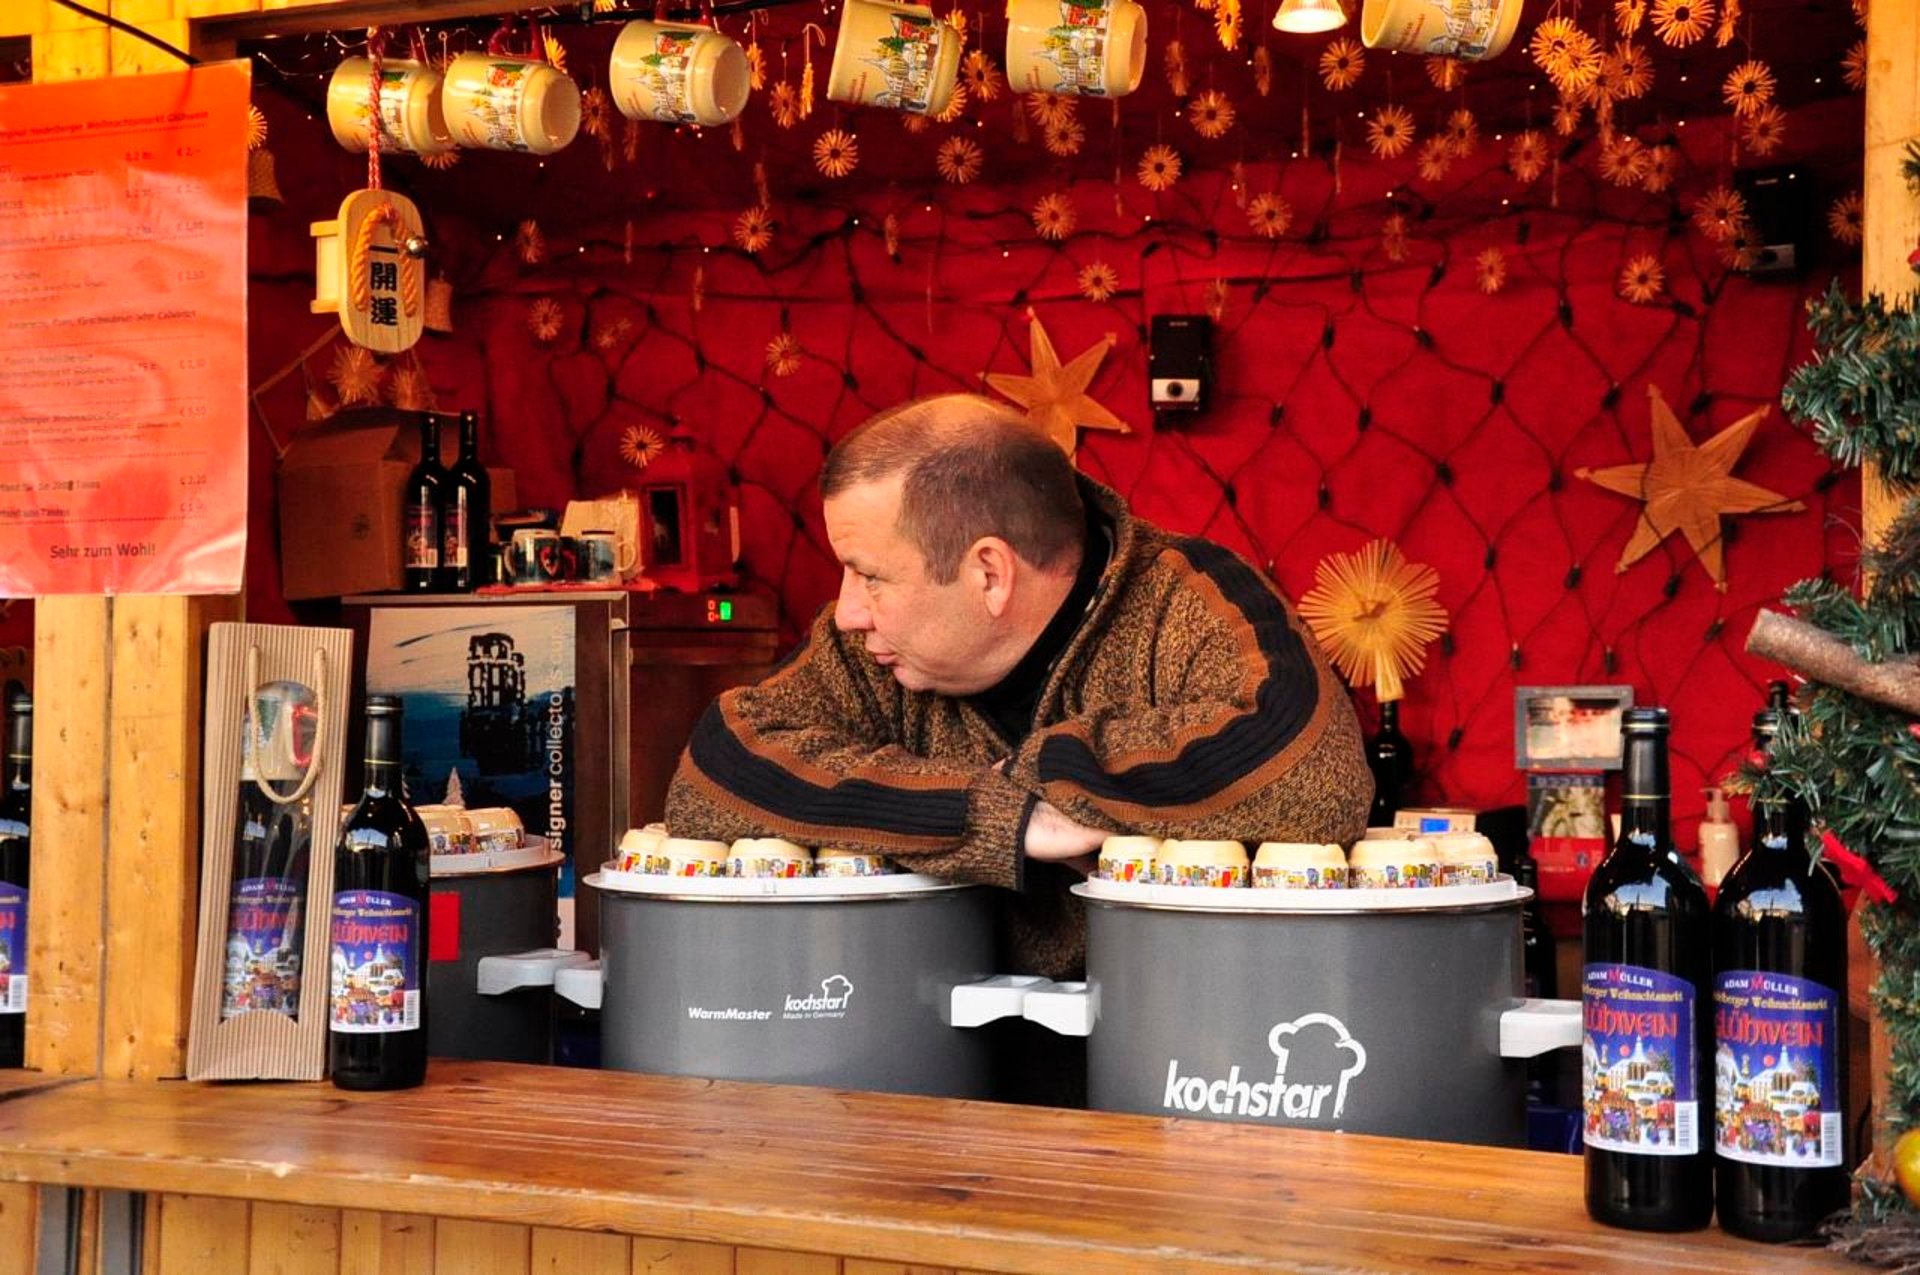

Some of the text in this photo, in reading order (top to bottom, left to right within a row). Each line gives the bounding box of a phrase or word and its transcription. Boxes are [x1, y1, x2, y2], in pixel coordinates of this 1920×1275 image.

[50, 545, 79, 559] Sehr
[84, 546, 112, 558] zum
[546, 778, 567, 850] signer
[688, 993, 846, 1021] WarmMaster kochstar
[783, 1012, 803, 1020] Made
[813, 1011, 846, 1020] Germany
[1163, 1059, 1333, 1120] kochstar
